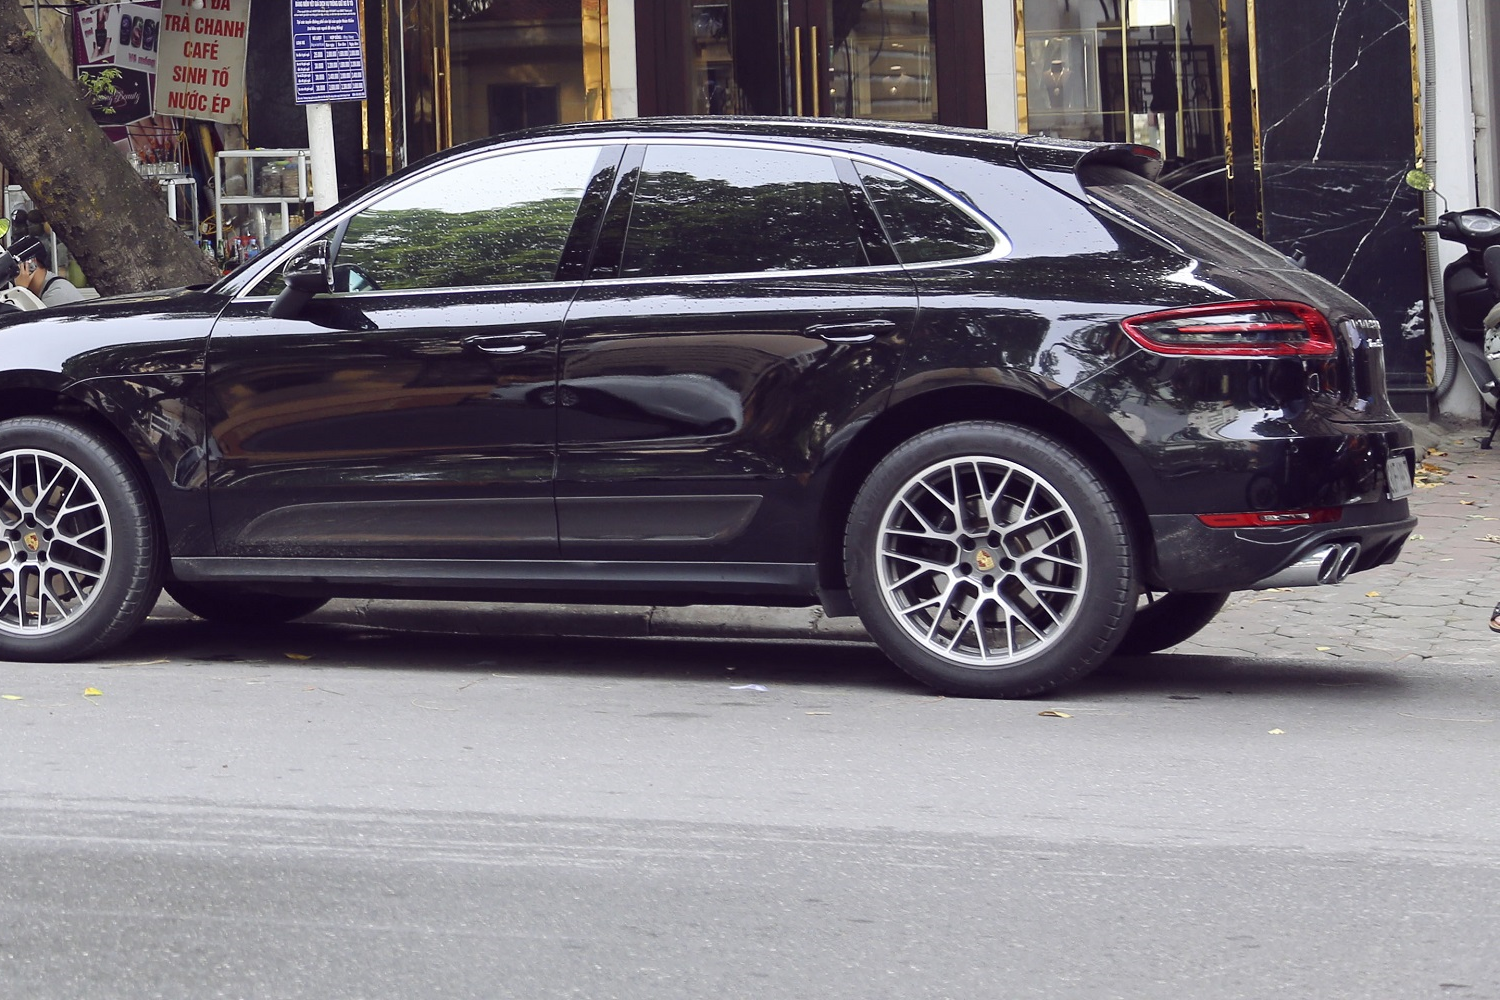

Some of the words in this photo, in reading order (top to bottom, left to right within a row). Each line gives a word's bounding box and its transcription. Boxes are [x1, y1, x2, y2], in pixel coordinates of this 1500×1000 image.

[164, 12, 190, 33] TRÀ
[194, 17, 245, 39] CHANH
[183, 40, 219, 60] CAFÉ
[172, 65, 207, 85] SINH
[212, 66, 230, 87] TỐ
[168, 90, 208, 112] NƯỚC
[211, 93, 231, 113] ÉP
